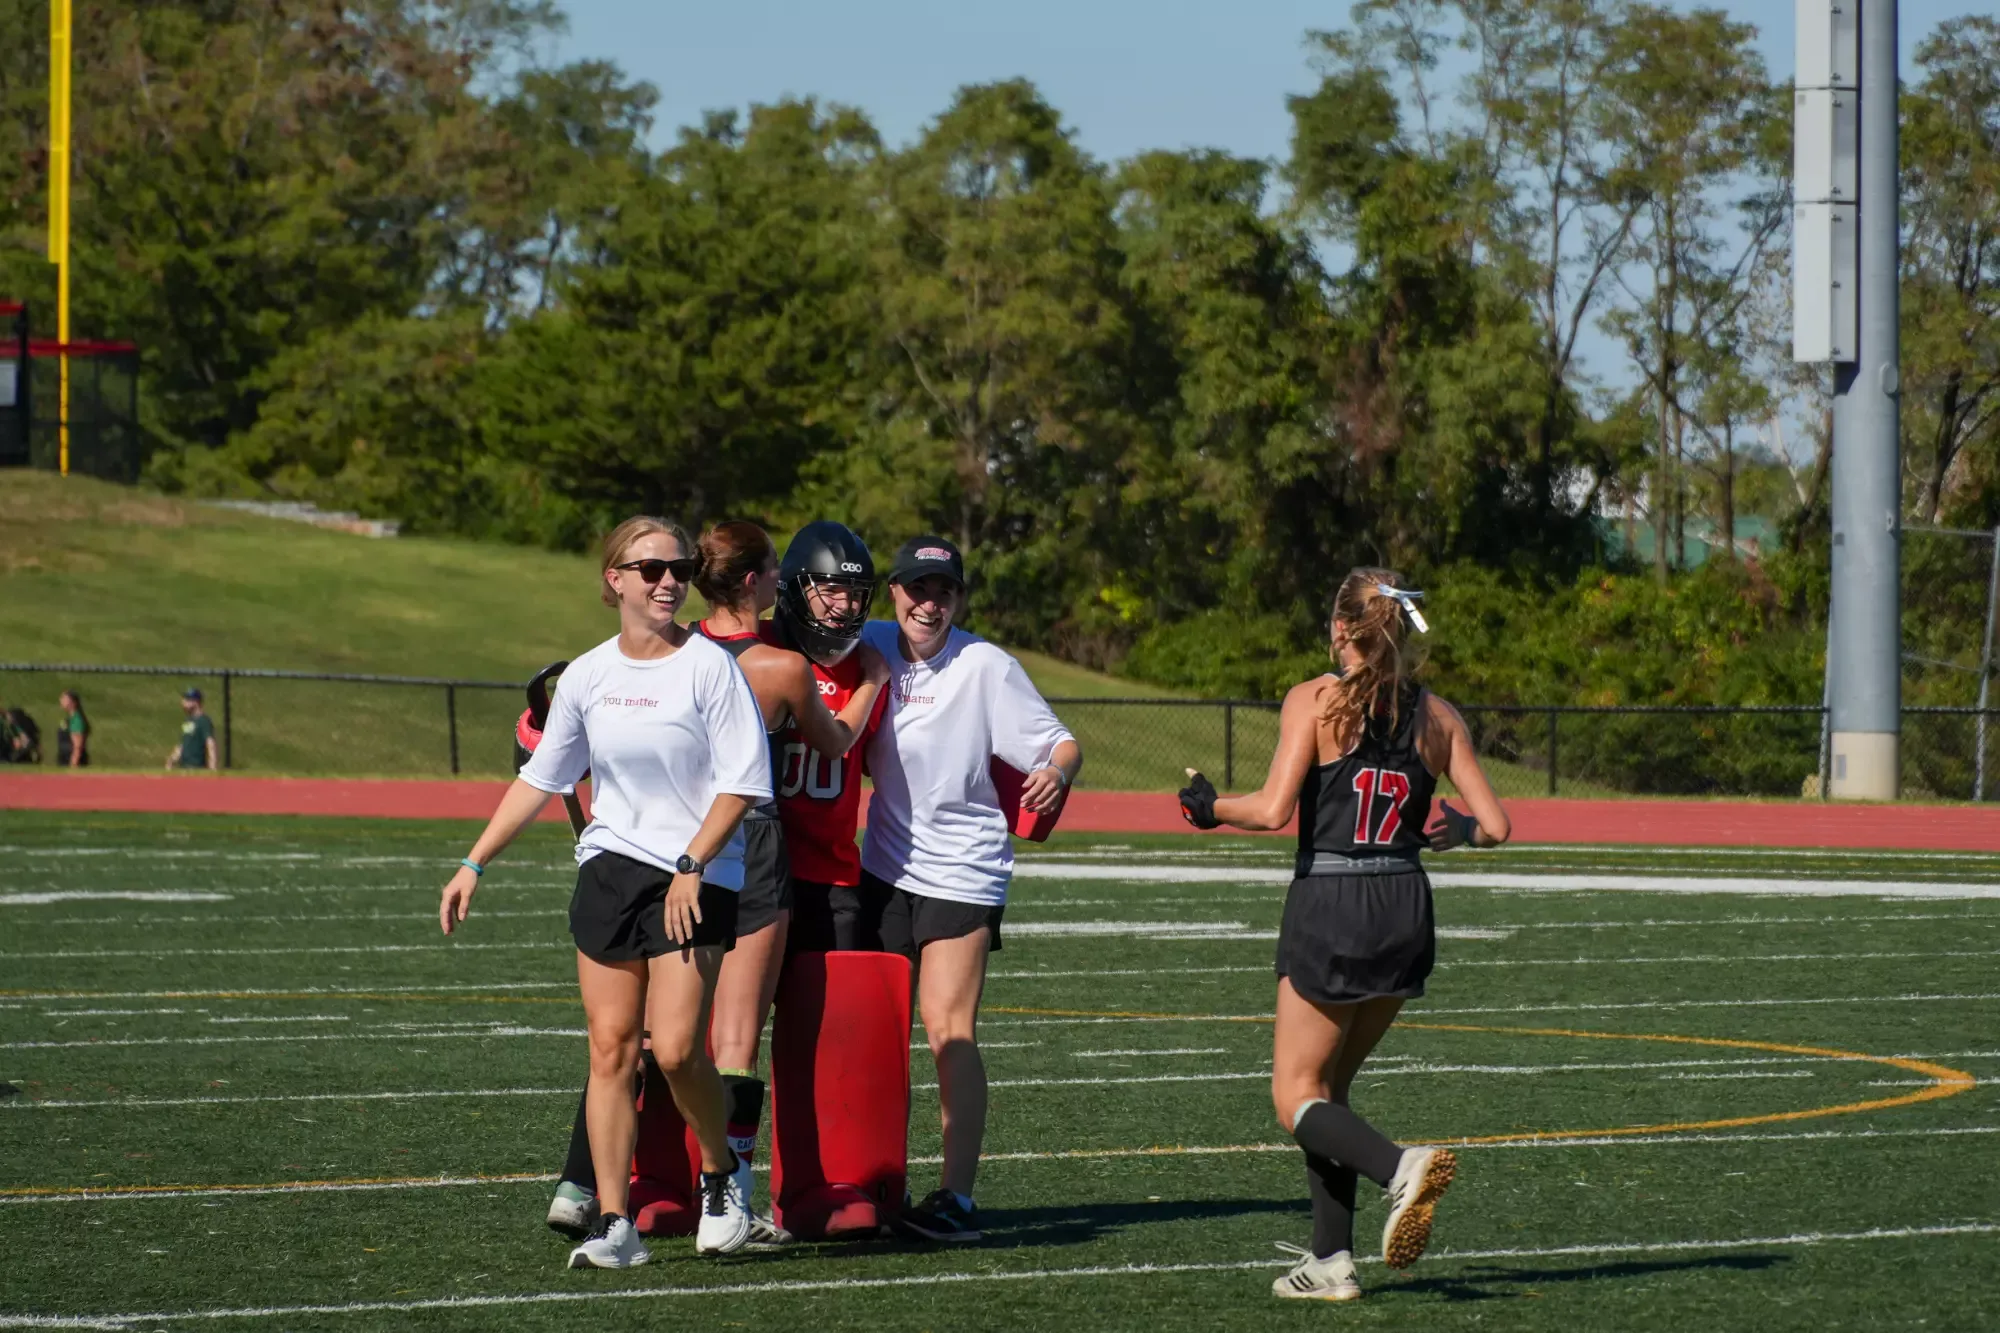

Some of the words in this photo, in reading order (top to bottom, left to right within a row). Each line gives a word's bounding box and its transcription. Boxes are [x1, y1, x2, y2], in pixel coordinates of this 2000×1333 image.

[841, 562, 862, 572] OBO
[816, 680, 837, 695] BO
[603, 697, 621, 707] you
[625, 697, 659, 708] matter
[1352, 767, 1411, 845] 17
